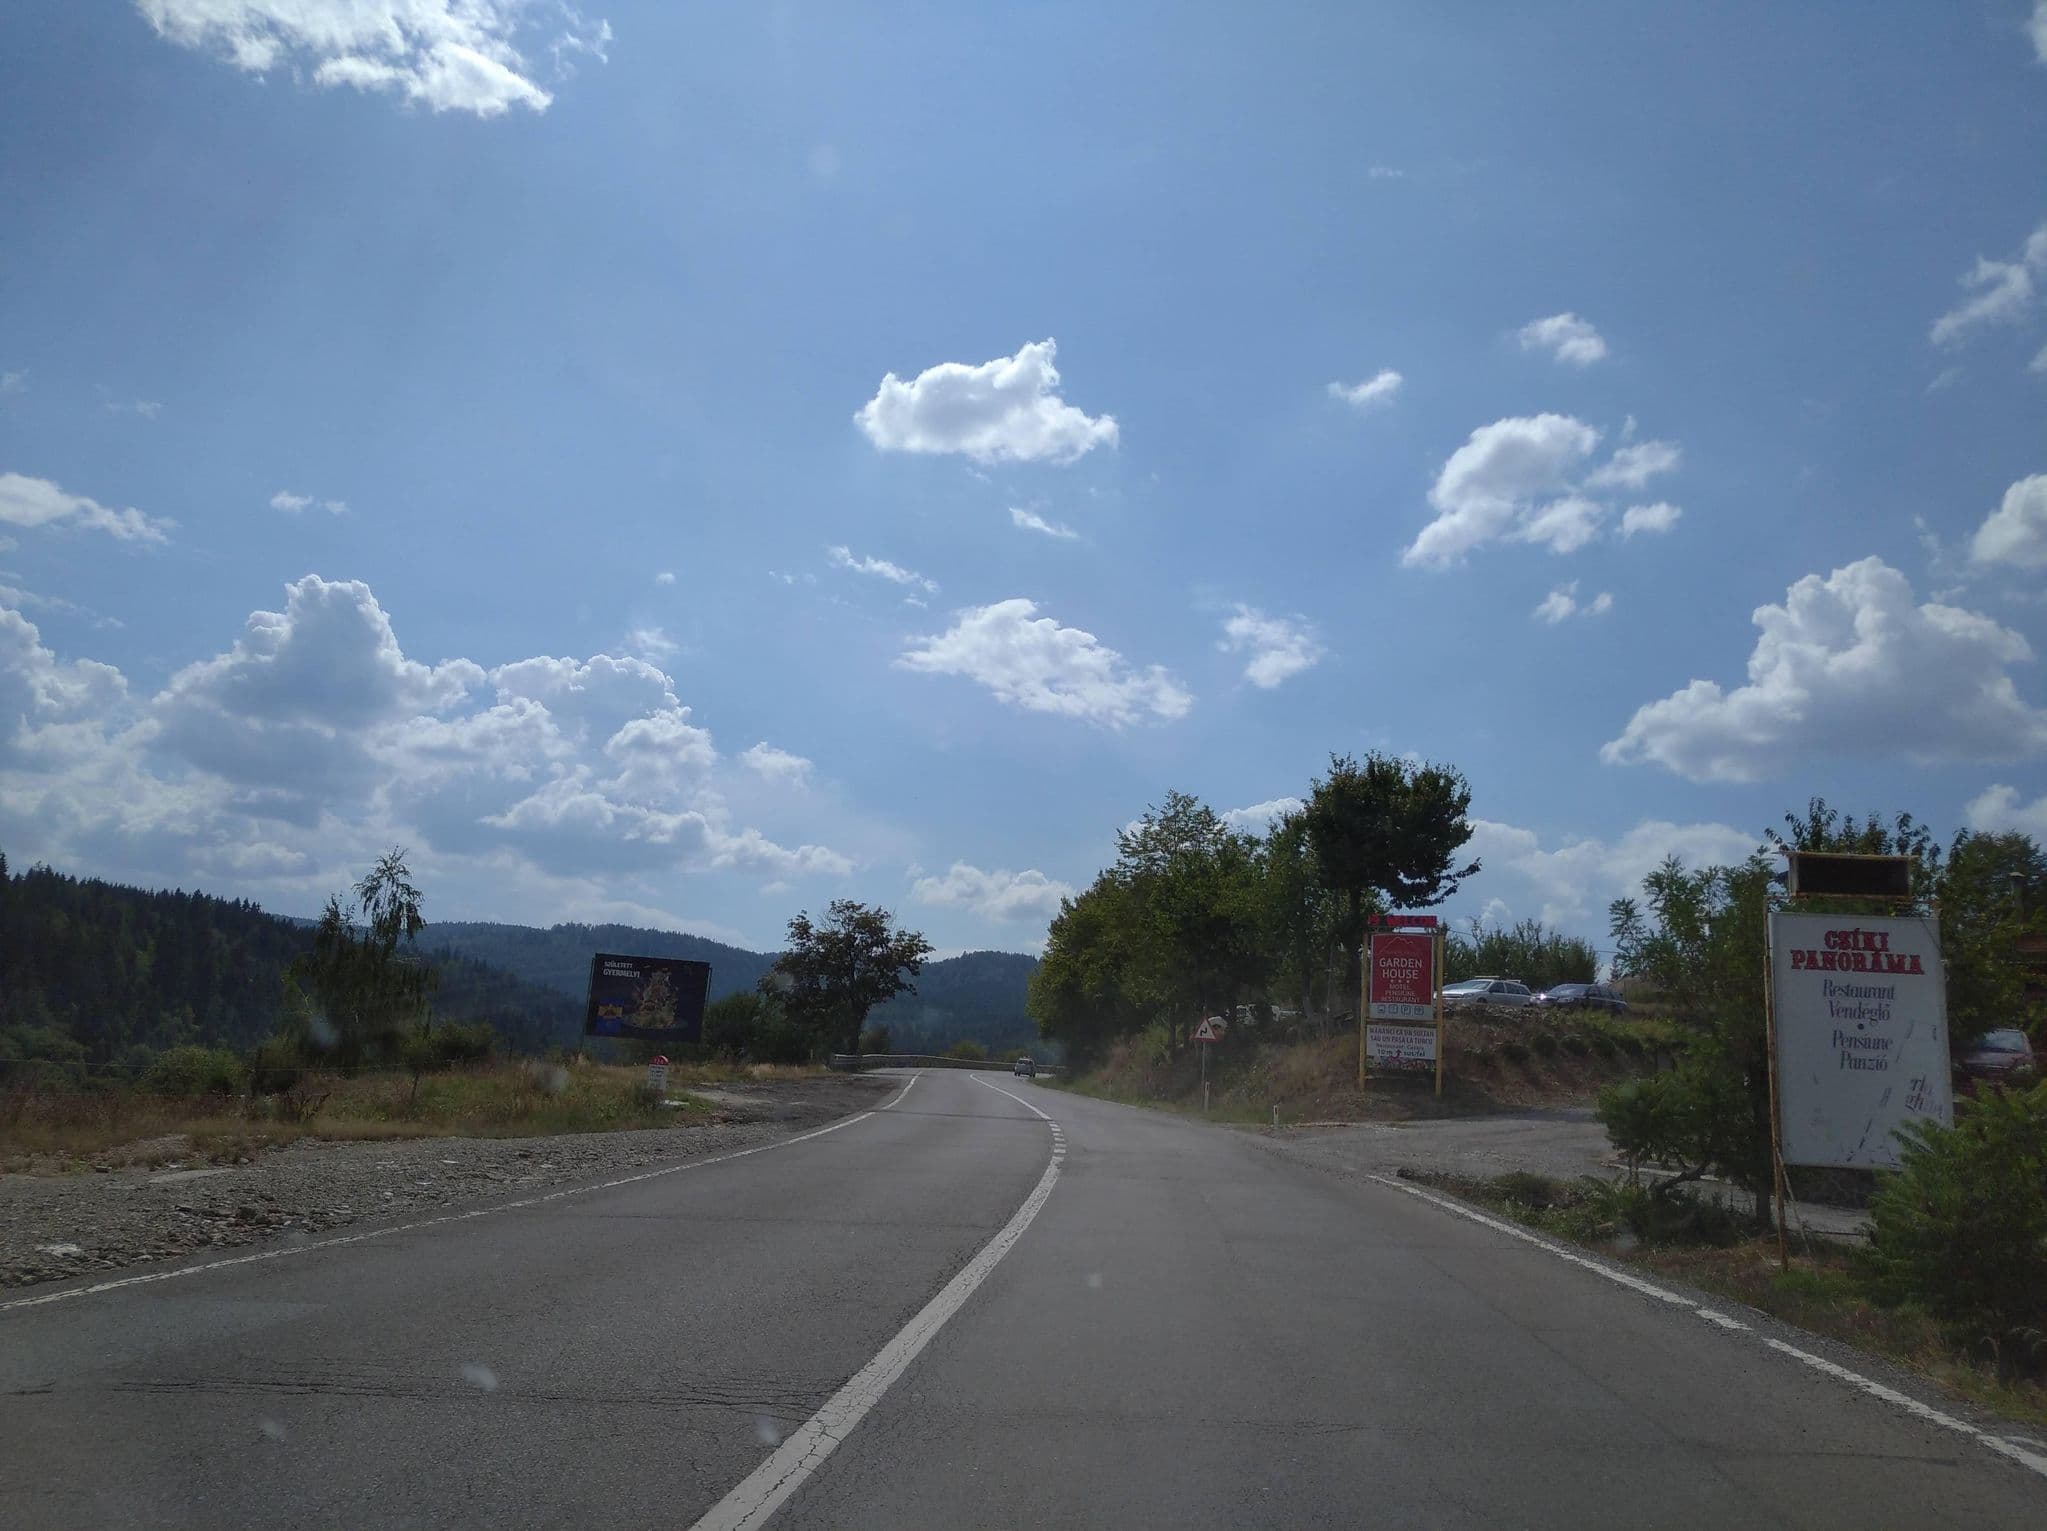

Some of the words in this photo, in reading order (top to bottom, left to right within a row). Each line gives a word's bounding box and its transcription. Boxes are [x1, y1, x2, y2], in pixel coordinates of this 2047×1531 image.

[1824, 928, 1890, 951] CSÍKI
[1379, 957, 1422, 968] GARDEN
[1790, 949, 1925, 975] PANORÁMA
[1382, 969, 1419, 979] HOUSE
[1823, 979, 1895, 1000] Restaurant
[1829, 1000, 1891, 1026] Vendéglő
[1833, 1029, 1893, 1050] Pensiune
[1840, 1050, 1889, 1071] Panzió
